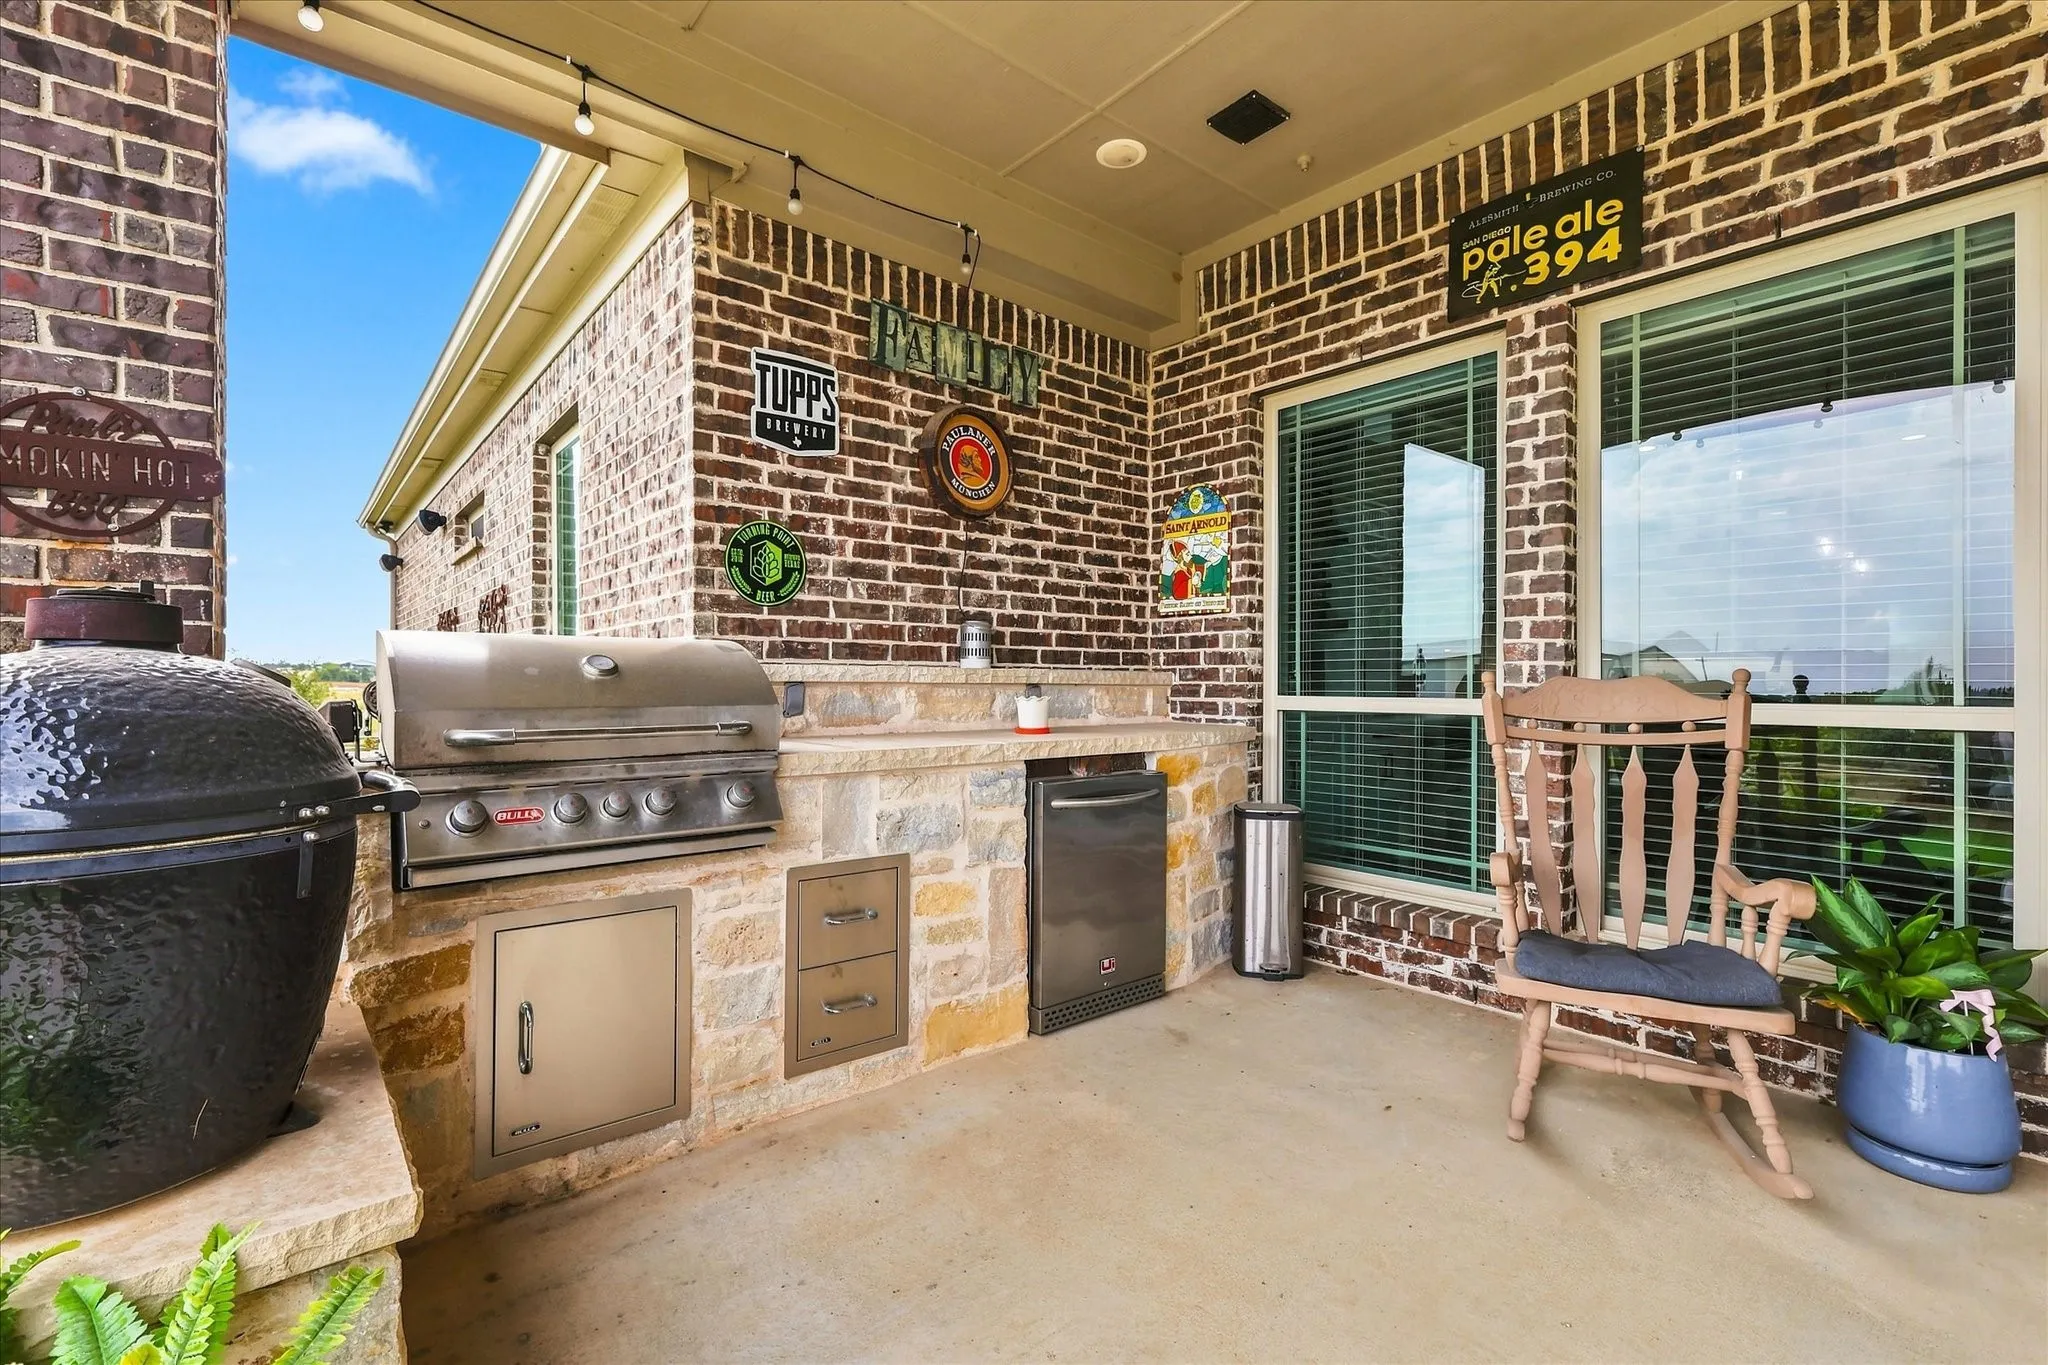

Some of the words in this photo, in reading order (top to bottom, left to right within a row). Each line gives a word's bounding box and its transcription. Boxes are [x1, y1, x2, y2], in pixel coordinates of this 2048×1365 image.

[1539, 177, 1593, 203] BREWING
[1462, 237, 1481, 250] SAN
[1482, 225, 1512, 242] DIEGO
[1462, 224, 1549, 282] pale
[1554, 198, 1624, 241] ale
[868, 300, 1037, 407] FAMILY
[755, 362, 836, 423] TUPPS
[766, 417, 826, 440] BREWERY
[941, 426, 996, 457] PAULANER
[133, 455, 193, 490] HOT
[737, 523, 771, 544] TURNING
[772, 527, 796, 549] POINT
[1165, 521, 1190, 535] SAINT
[1189, 516, 1227, 534] ARNOLD
[756, 589, 776, 602] BEER
